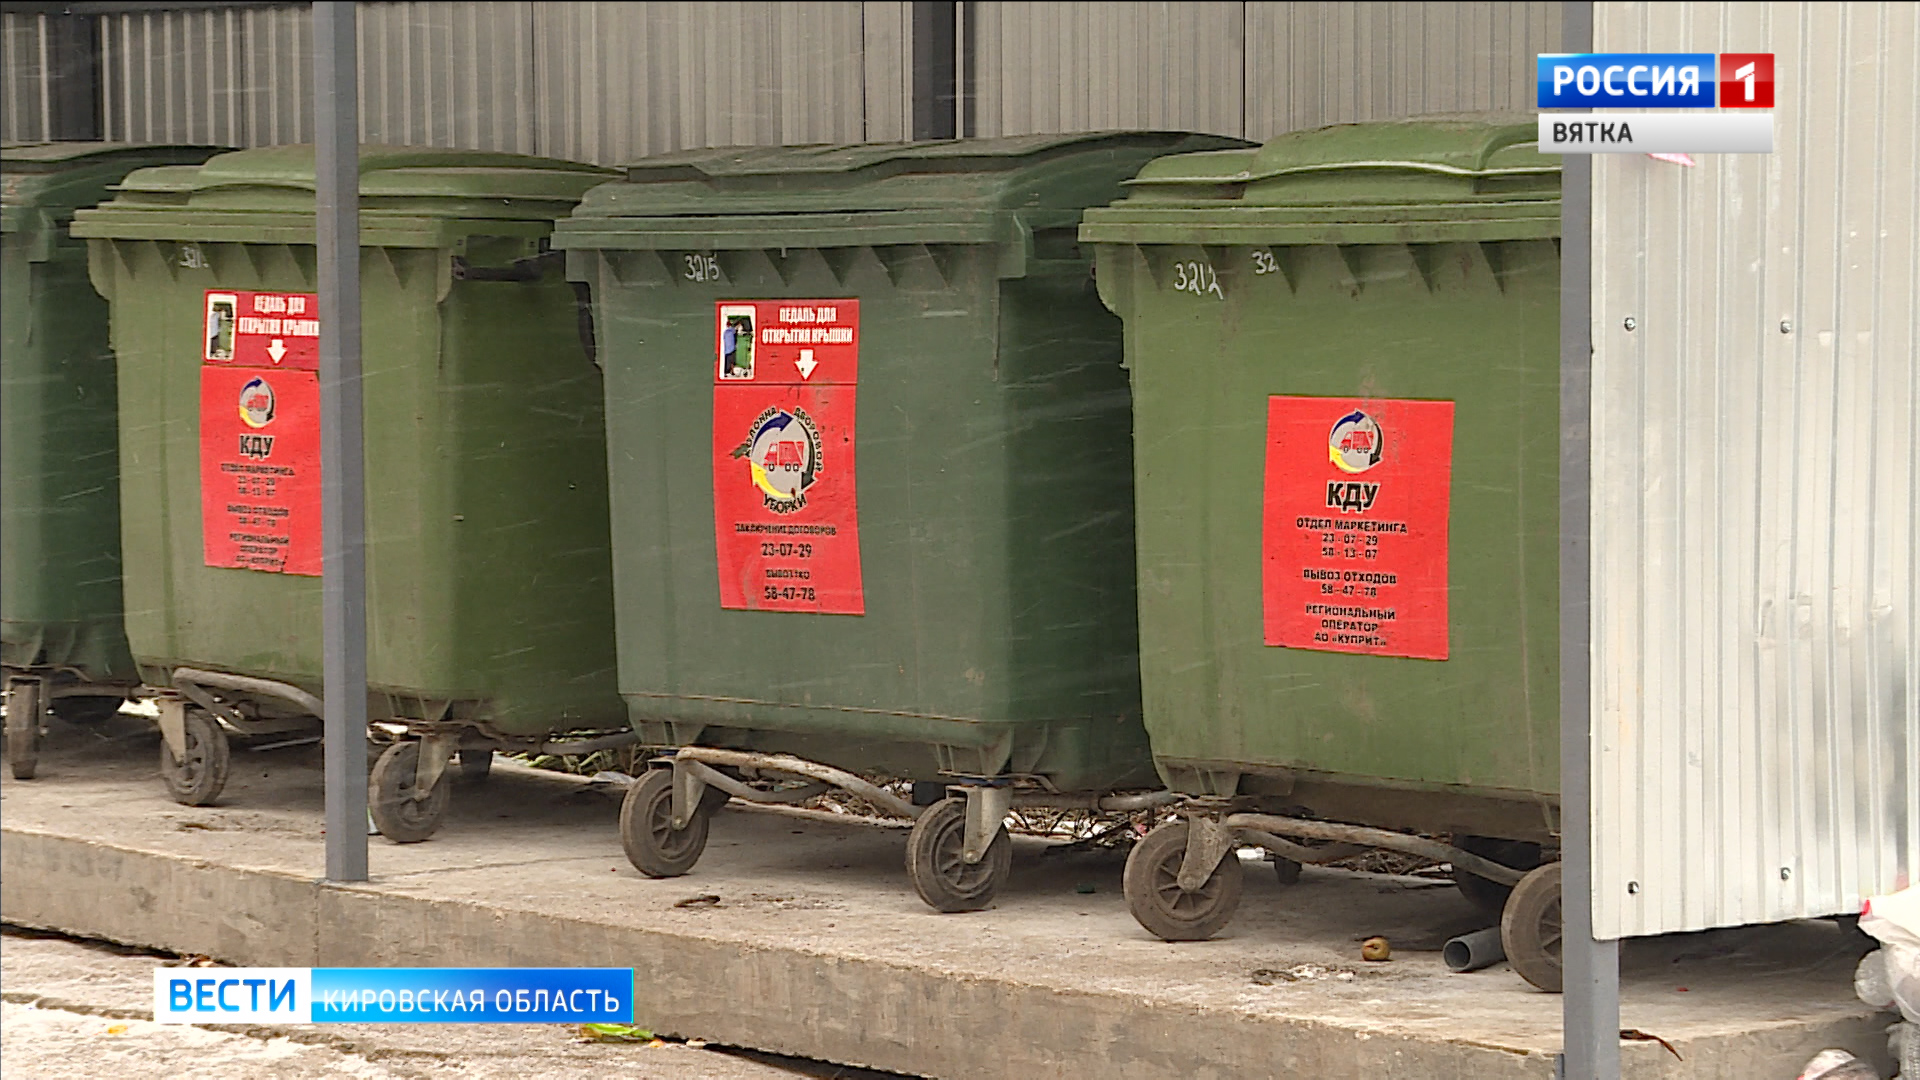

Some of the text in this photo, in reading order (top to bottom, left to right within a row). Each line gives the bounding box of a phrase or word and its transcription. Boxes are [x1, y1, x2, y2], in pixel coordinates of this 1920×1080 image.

[685, 252, 719, 281] 3215
[1174, 261, 1223, 300] 3212
[780, 307, 836, 325] ПЕДАЛЬ ДЛЯ
[762, 328, 853, 344] ОТКРЫТИЯ КРЫШКИ
[239, 434, 274, 459] КДУ
[763, 493, 807, 513] УБОРКИ
[1326, 482, 1379, 512] КДУ
[1296, 517, 1408, 534] ОТДЕЛ МАРКЕТИНГА
[761, 542, 812, 558] 23-07-29
[1303, 569, 1397, 585] ВЫВОЗ ОТХОДОВ
[764, 585, 816, 601] 58-47-78
[1305, 604, 1396, 620] РЕГИОНАЛЬНЫЙ
[1321, 619, 1379, 632] ОПЕРАТОР
[1314, 632, 1329, 642] АО
